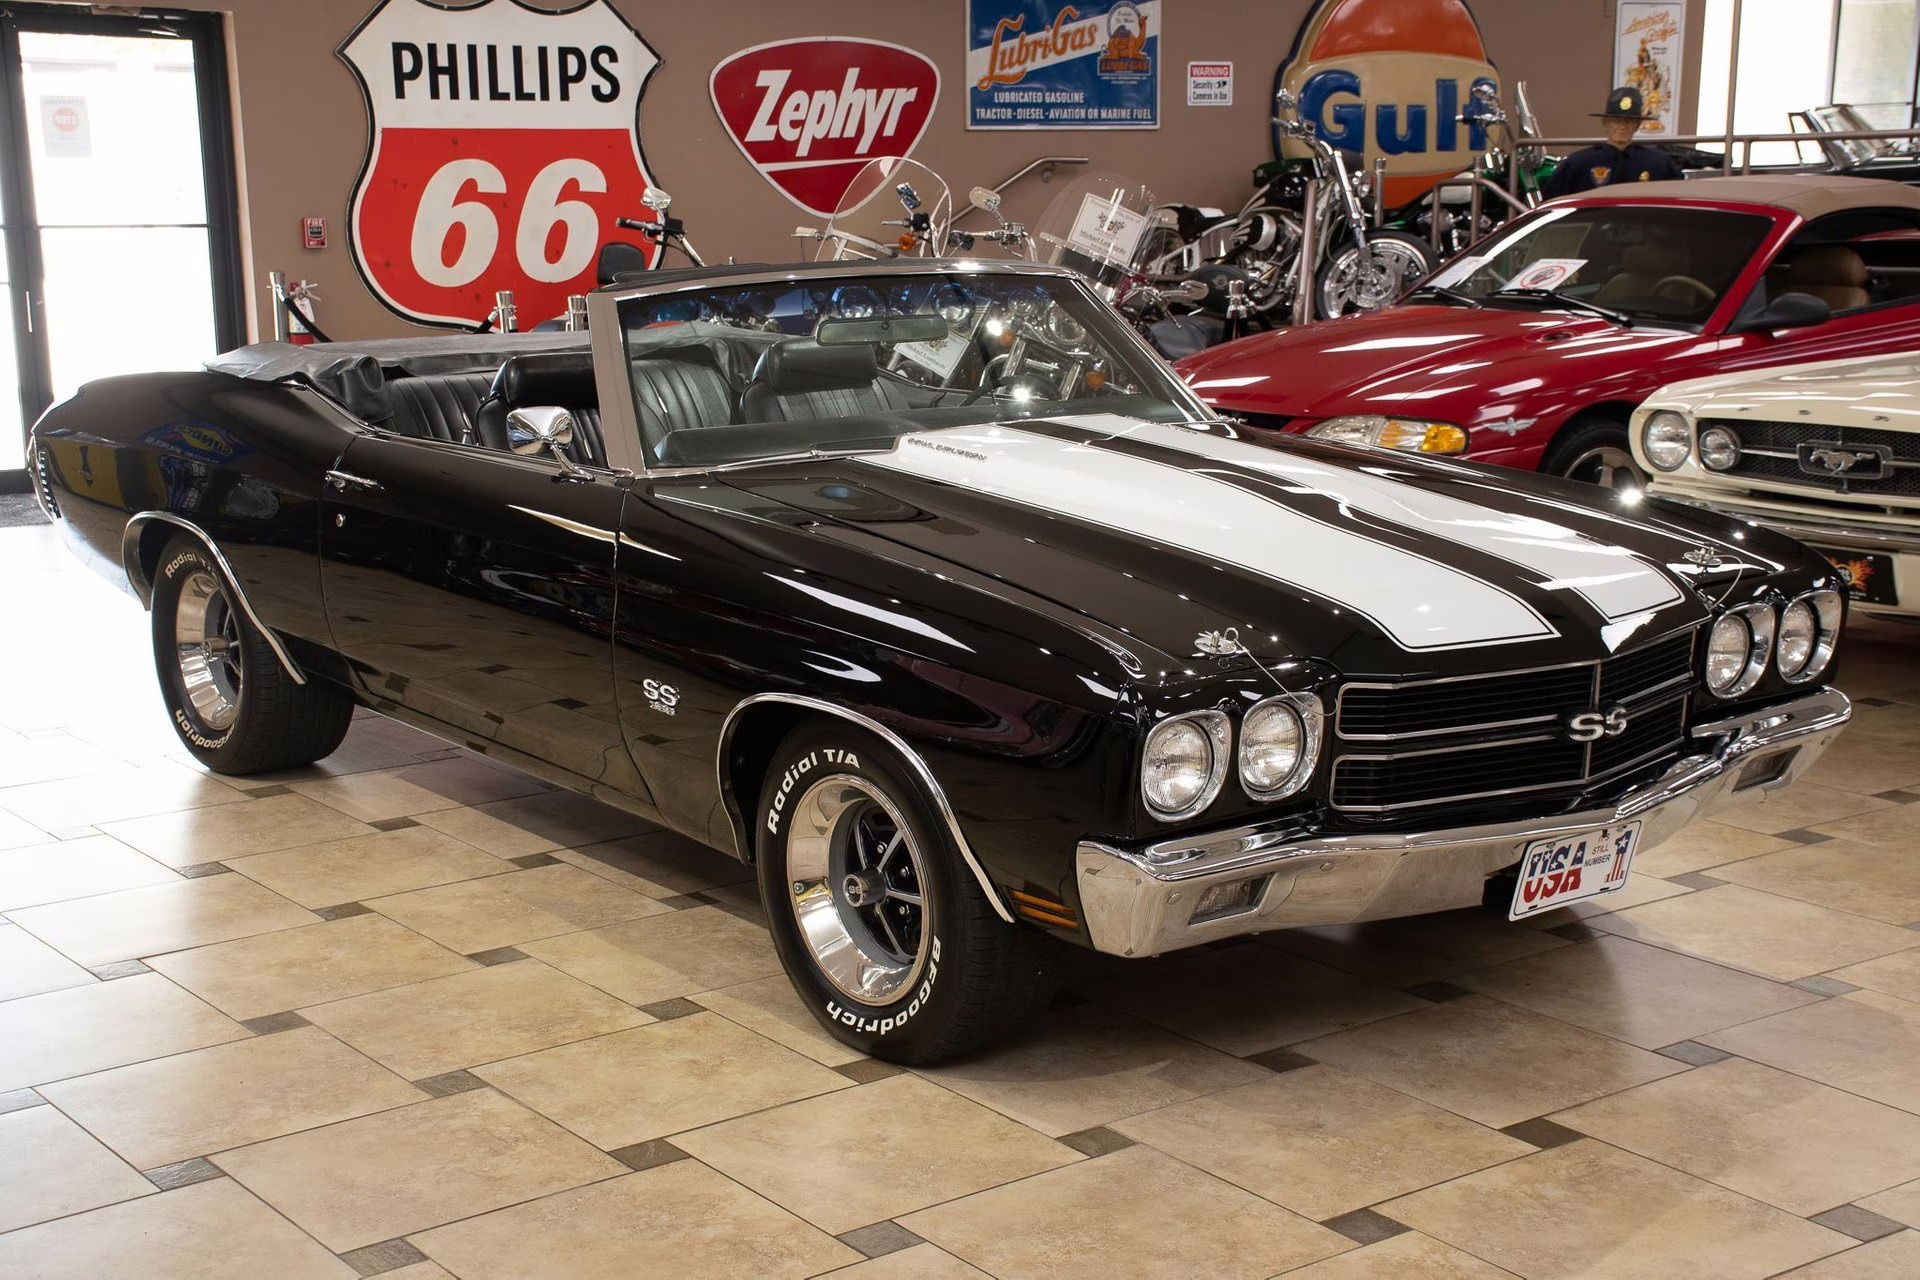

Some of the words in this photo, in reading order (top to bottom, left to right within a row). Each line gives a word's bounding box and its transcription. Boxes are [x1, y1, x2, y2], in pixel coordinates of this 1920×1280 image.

[392, 42, 620, 103] PHILLIPS
[1191, 66, 1229, 76] WARNING
[994, 92, 1042, 103] LUBRICATED
[1044, 92, 1085, 103] GASOLINE
[1193, 80, 1213, 91] Security
[1193, 91, 1212, 100] Cameras
[744, 67, 918, 157] Zephyr
[1087, 109, 1099, 119] OR
[1100, 109, 1132, 119] MARINE
[1133, 109, 1152, 119] FUEL
[411, 158, 608, 288] 66
[165, 552, 197, 579] Radial
[642, 678, 678, 707] SS
[1569, 706, 1628, 742] SS
[767, 751, 818, 835] Radial
[1584, 854, 1611, 868] NUMBER
[1592, 845, 1609, 855] STILL
[1523, 841, 1587, 903] USA
[1604, 829, 1633, 883] 1
[826, 935, 941, 1035] BFGoodrich
